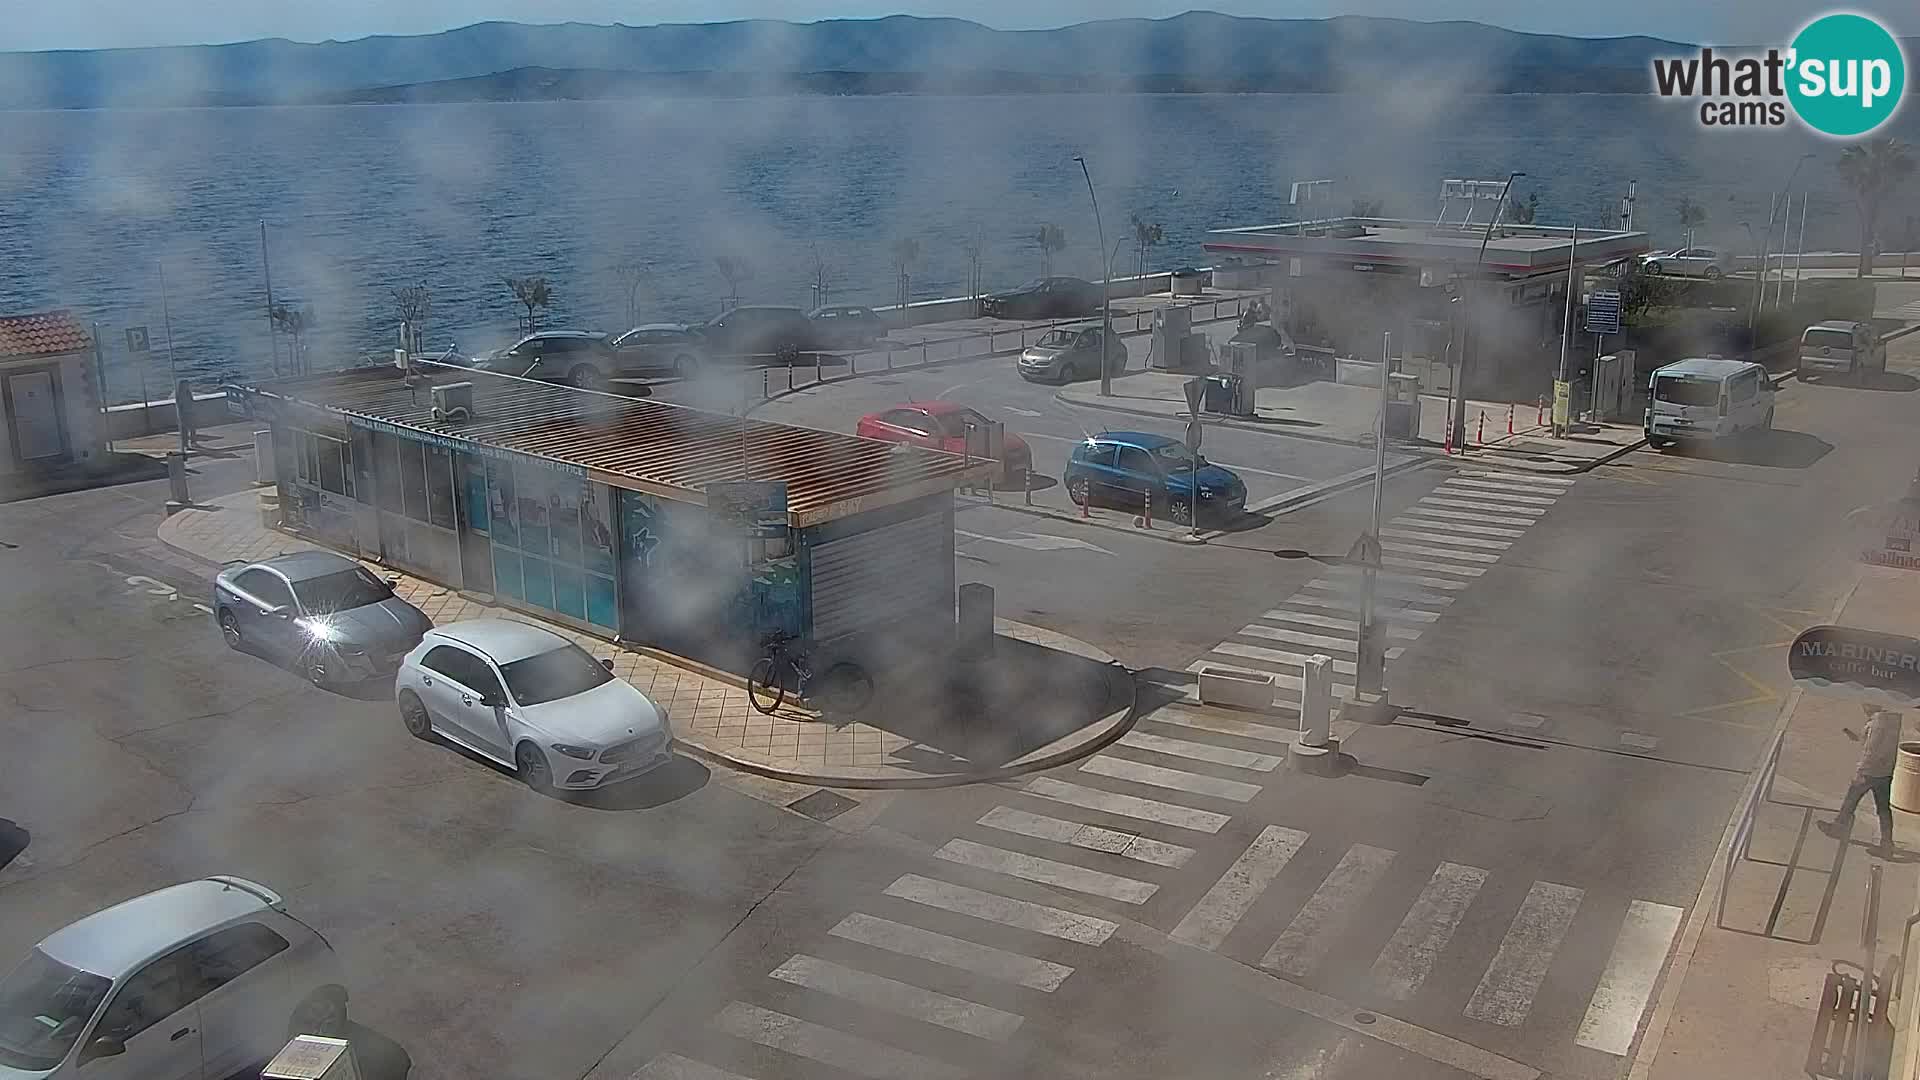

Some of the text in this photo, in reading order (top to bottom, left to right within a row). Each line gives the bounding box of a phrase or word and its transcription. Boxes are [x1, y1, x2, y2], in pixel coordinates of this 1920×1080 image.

[436, 436, 469, 450] POSTAJA
[556, 462, 583, 476] OFFICE
[1800, 641, 1920, 672] MARINER
[1871, 664, 1897, 679] bar
